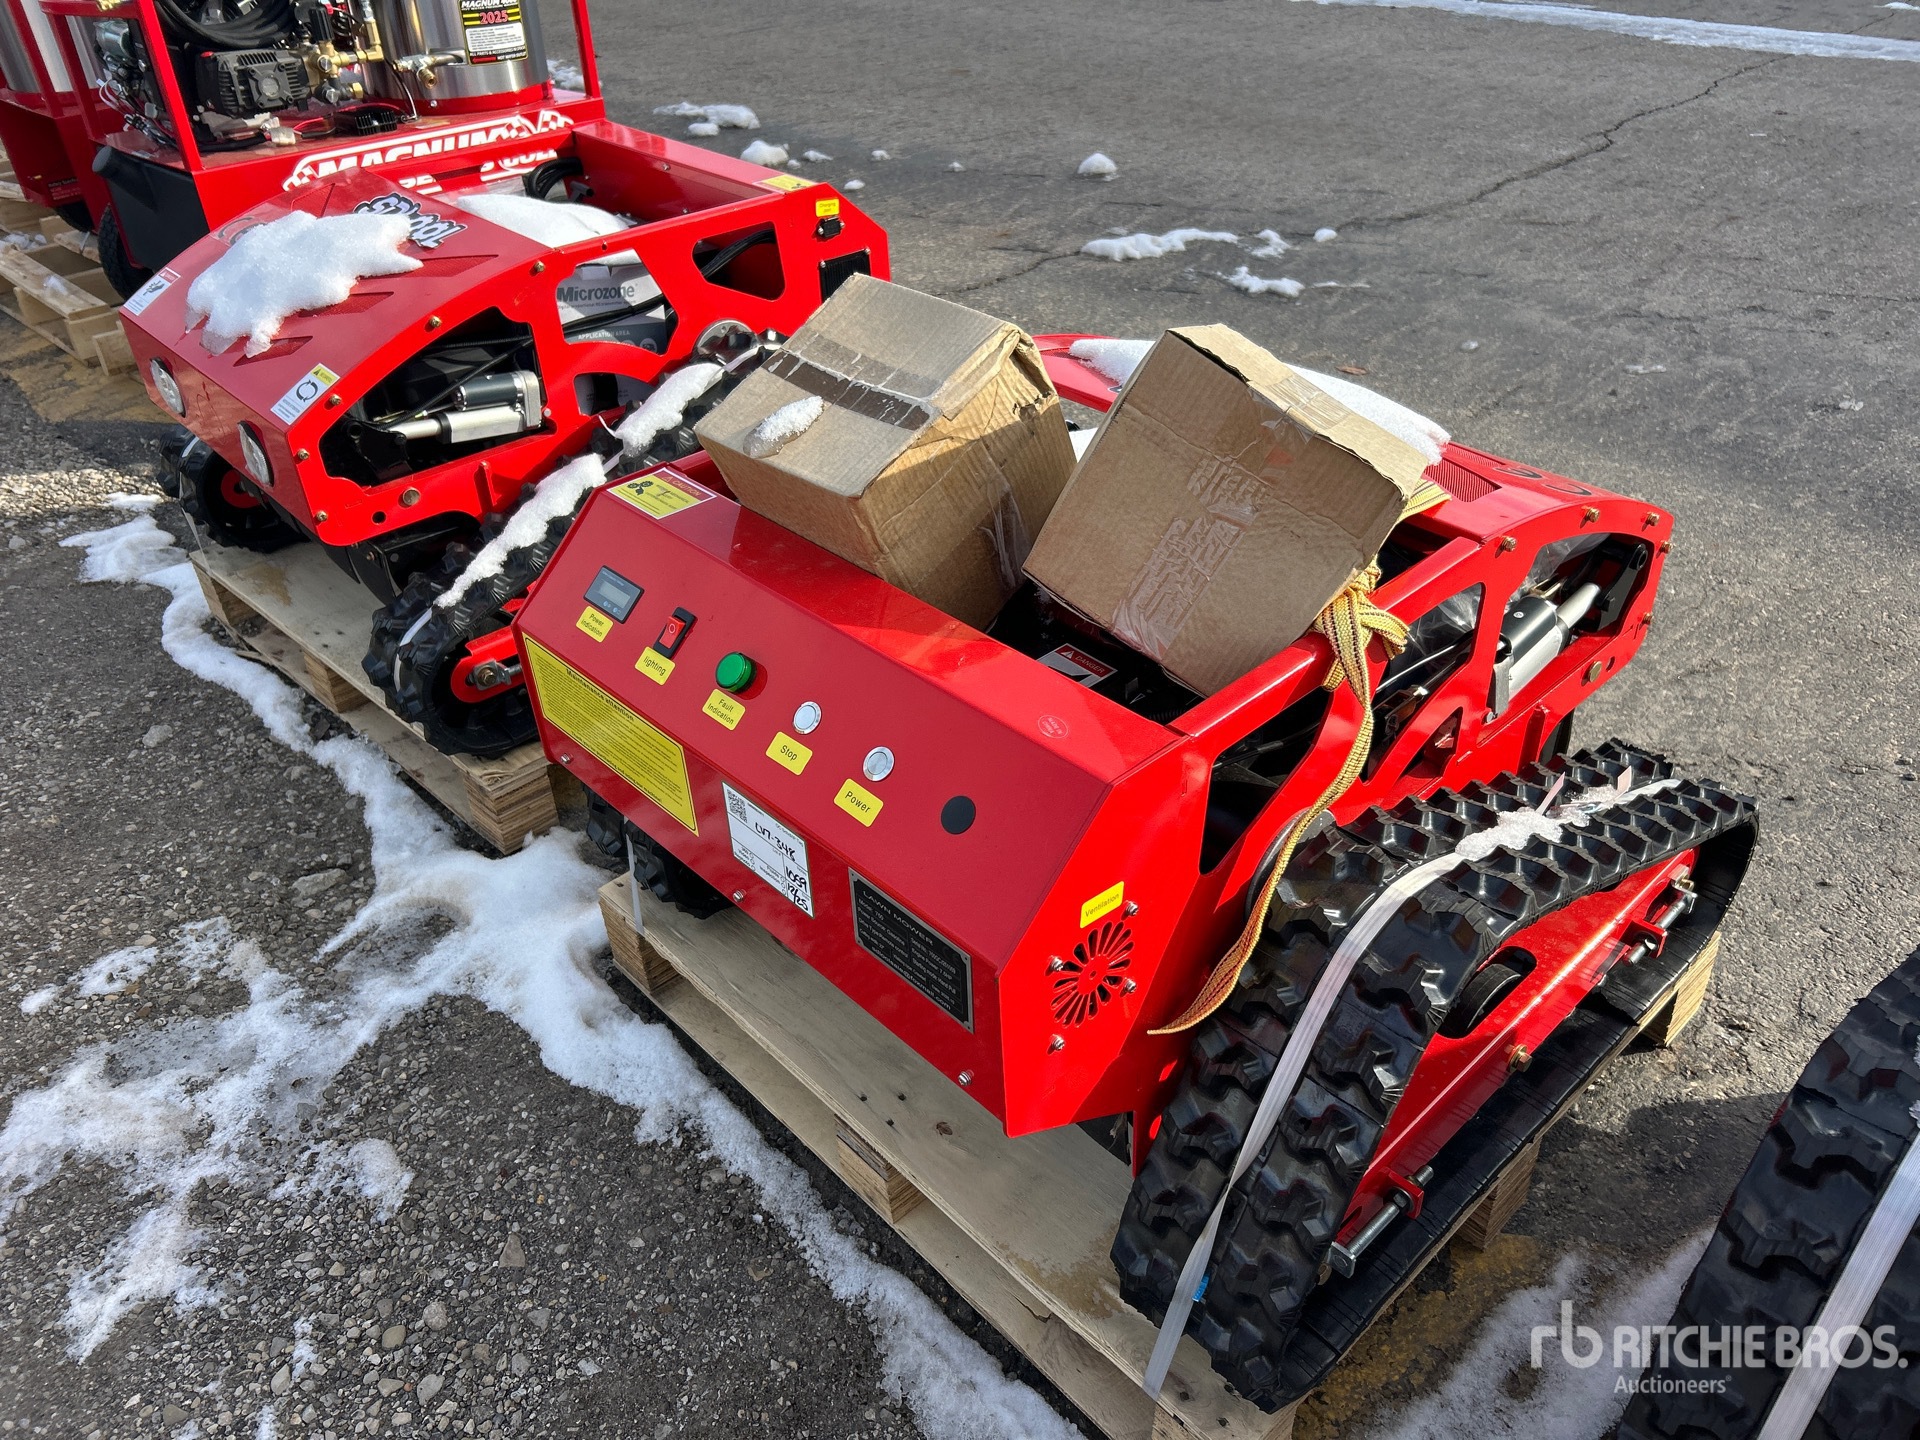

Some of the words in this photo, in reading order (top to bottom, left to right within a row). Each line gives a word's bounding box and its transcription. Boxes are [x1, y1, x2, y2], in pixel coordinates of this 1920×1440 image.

[480, 10, 508, 24] 2025
[557, 285, 635, 302] Microzone
[672, 480, 702, 497] CAUTION
[589, 613, 604, 627] Power
[1075, 656, 1105, 674] DANGER
[566, 668, 605, 701] Maintenance
[605, 697, 635, 722] attention
[707, 703, 735, 726] Indication
[718, 699, 734, 713] Fault
[780, 745, 798, 762] Stop
[845, 790, 871, 813] Power
[1085, 893, 1120, 917] Ventilation
[863, 890, 891, 914] LAWN
[893, 913, 934, 946] MOWER
